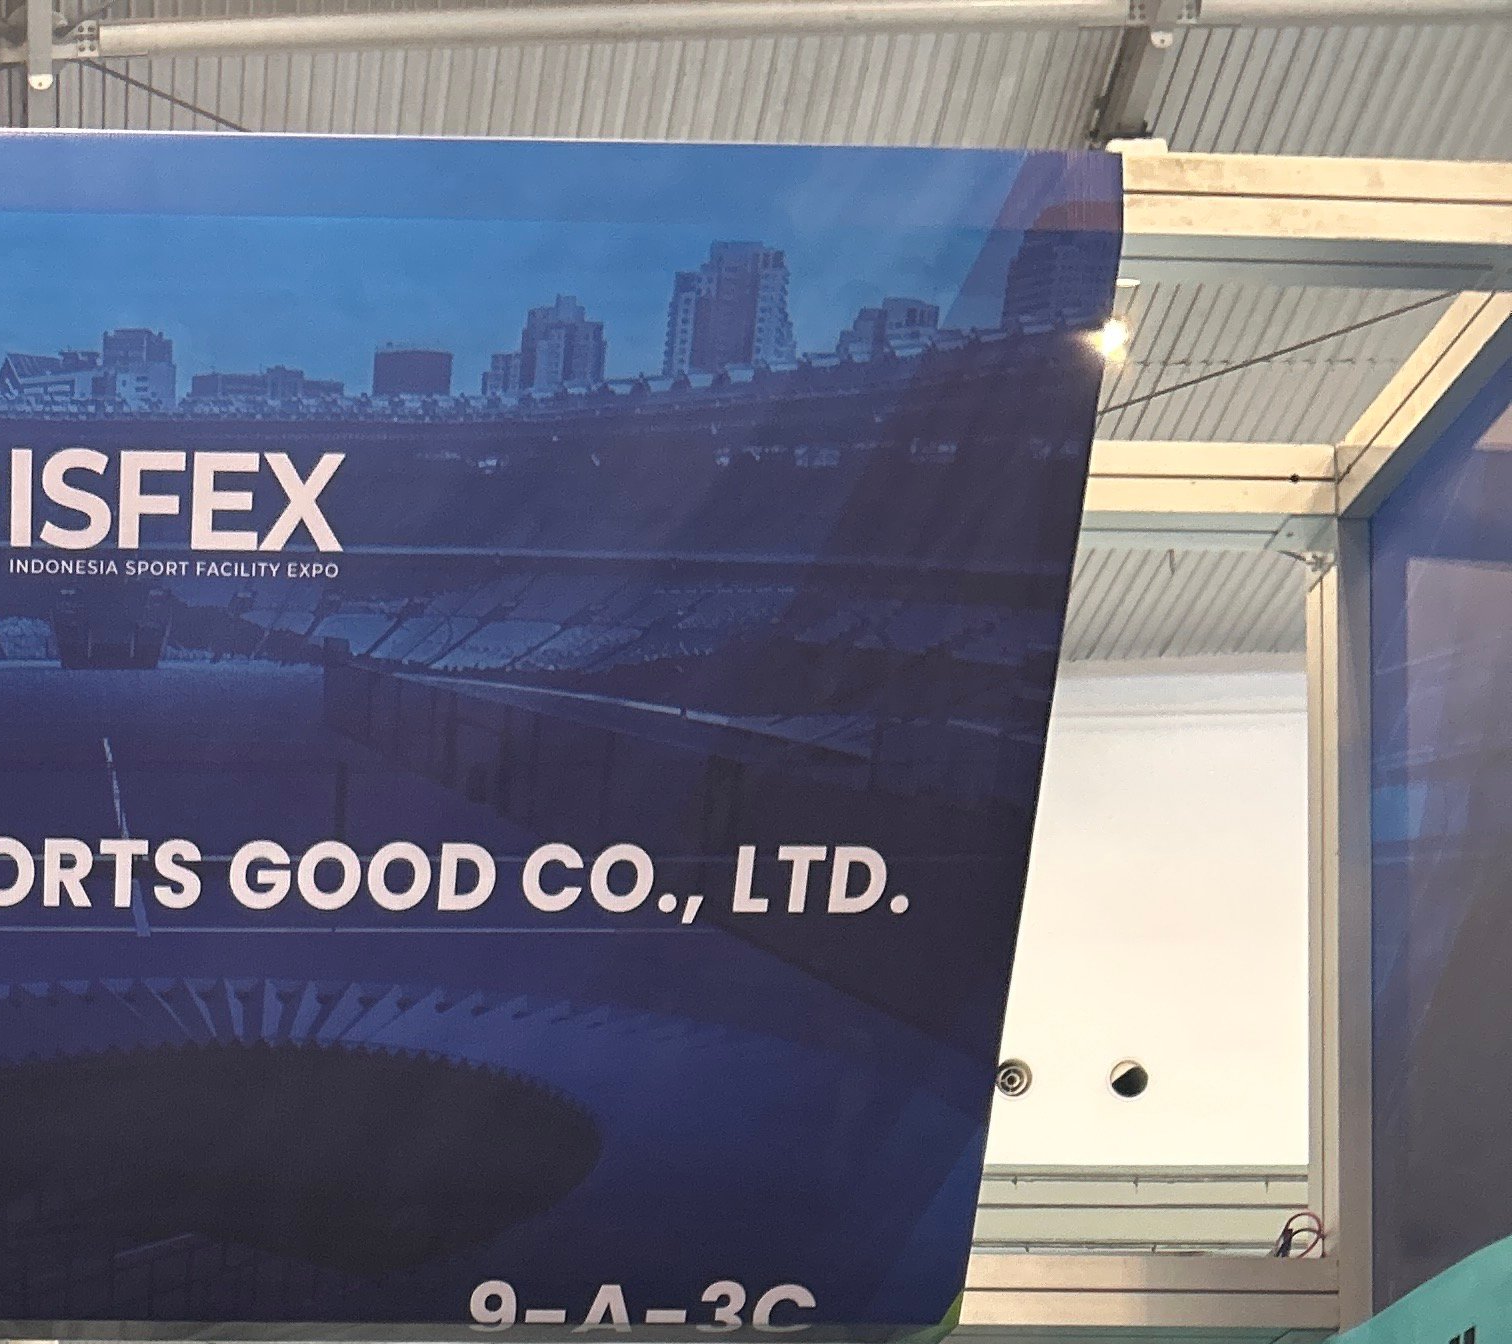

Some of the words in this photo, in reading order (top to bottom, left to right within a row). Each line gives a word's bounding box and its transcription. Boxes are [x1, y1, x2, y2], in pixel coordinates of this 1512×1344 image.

[10, 448, 345, 552] ISFEX
[9, 559, 118, 576] INDONESIA
[125, 560, 189, 577] SPORT
[196, 562, 280, 578] FACILITY
[287, 563, 339, 579] EXPO
[229, 839, 496, 912] GOOD
[522, 842, 702, 924] CO.,
[733, 845, 910, 915] LTD.
[469, 1280, 816, 1333] 9-A-3C
